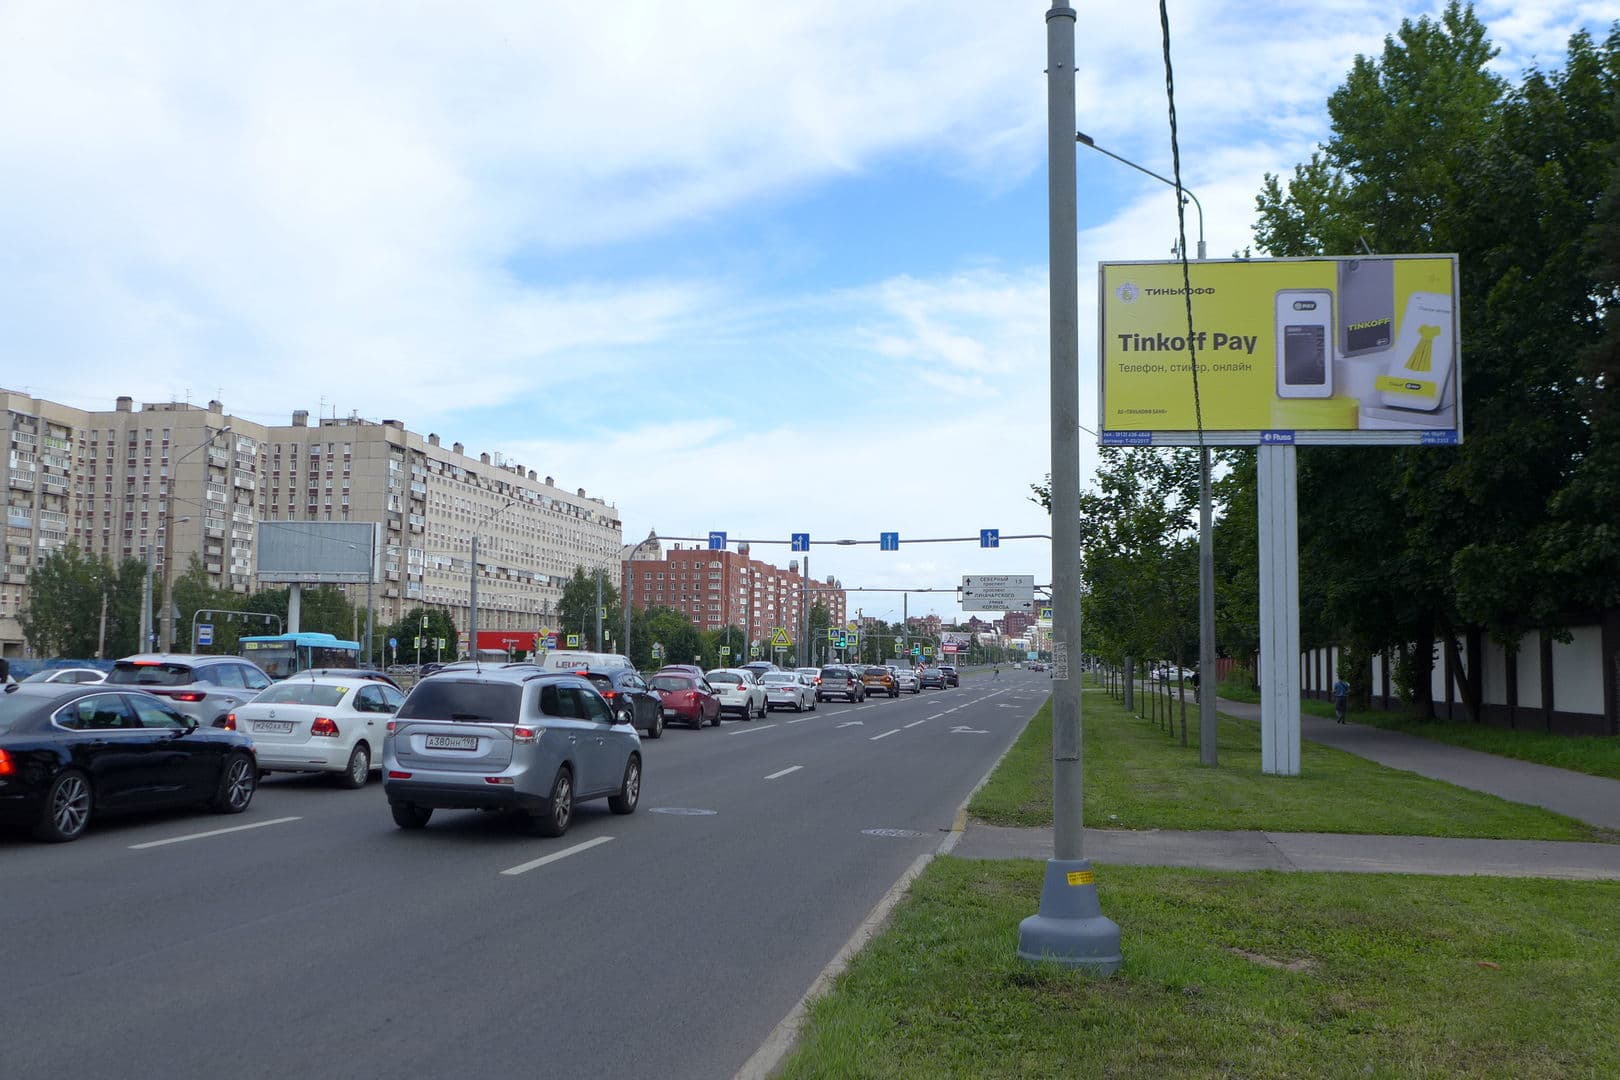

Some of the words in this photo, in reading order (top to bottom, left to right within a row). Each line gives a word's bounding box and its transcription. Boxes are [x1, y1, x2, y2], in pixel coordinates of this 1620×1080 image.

[1145, 287, 1215, 296] ТИНЬКОФФ
[1348, 318, 1391, 331] TINKOFF
[1118, 332, 1207, 352] Tinkoff
[1213, 333, 1258, 355] Pay
[1119, 363, 1167, 374] Телефон,
[1212, 362, 1252, 372] онлайн
